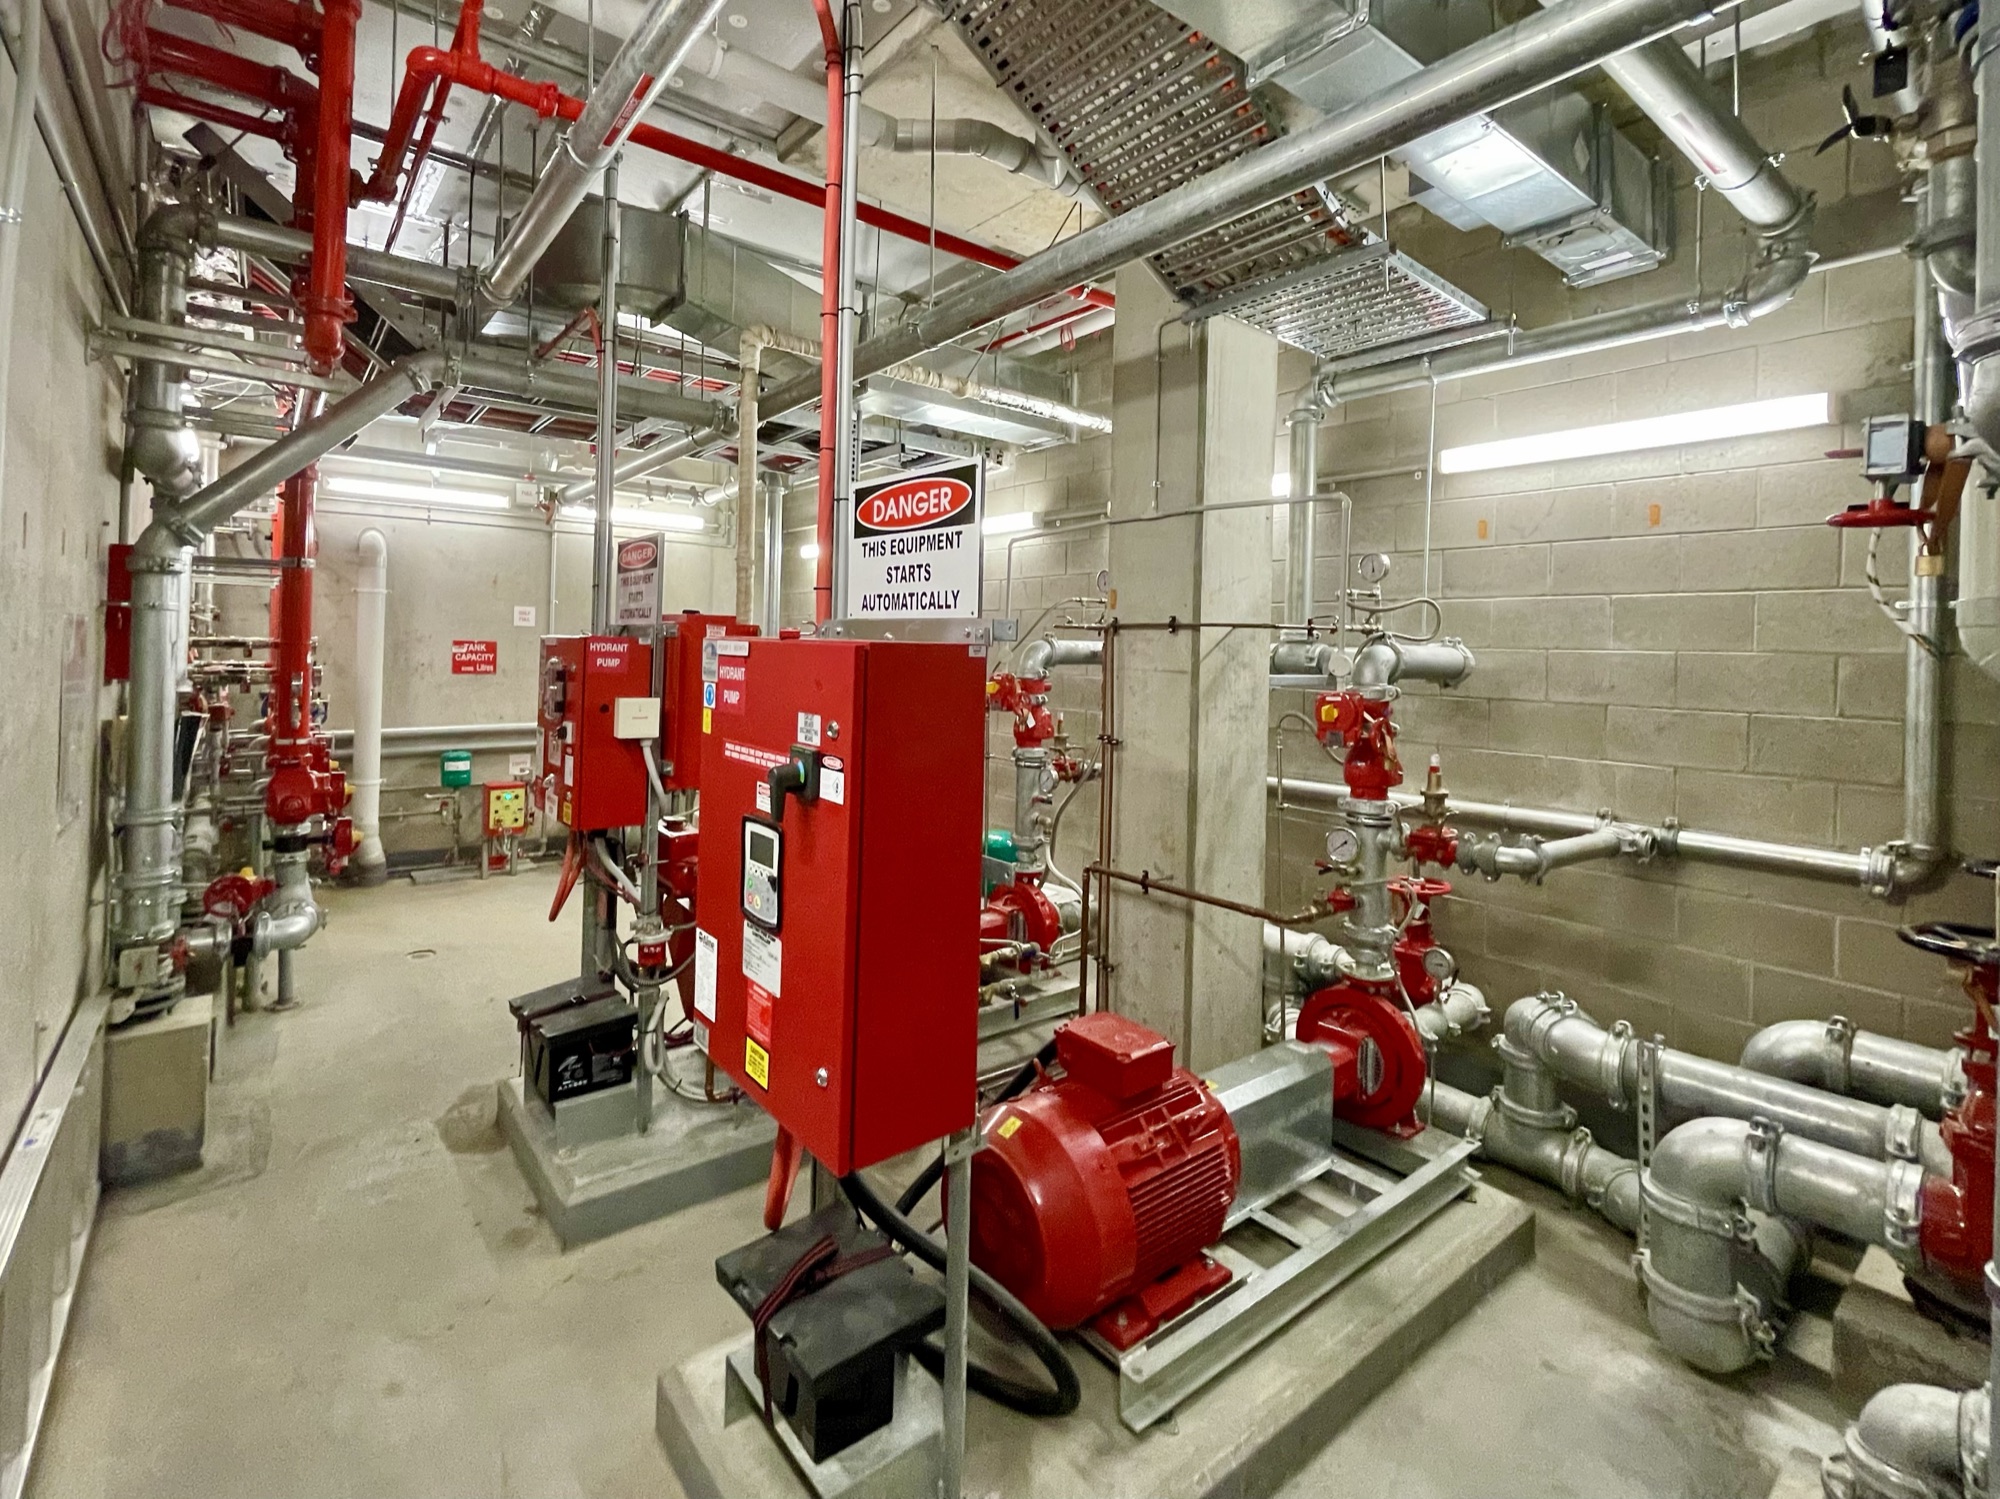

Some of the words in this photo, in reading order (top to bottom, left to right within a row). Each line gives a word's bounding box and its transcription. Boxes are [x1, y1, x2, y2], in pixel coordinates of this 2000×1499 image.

[873, 487, 952, 523] DANGER
[862, 540, 887, 558] THIS
[891, 531, 963, 555] EQUIPMENT
[622, 547, 653, 562] DANGER
[886, 563, 931, 584] STARTS
[862, 590, 960, 611] AUTOMATICALLY
[620, 607, 652, 619] AUTOMATICALLY
[464, 643, 487, 652] TANK
[590, 642, 629, 653] HYDRANT
[455, 653, 494, 662] CAPACITY
[596, 658, 621, 668] PUMP
[719, 665, 746, 681] HYDRANT
[723, 689, 741, 704] PUMP
